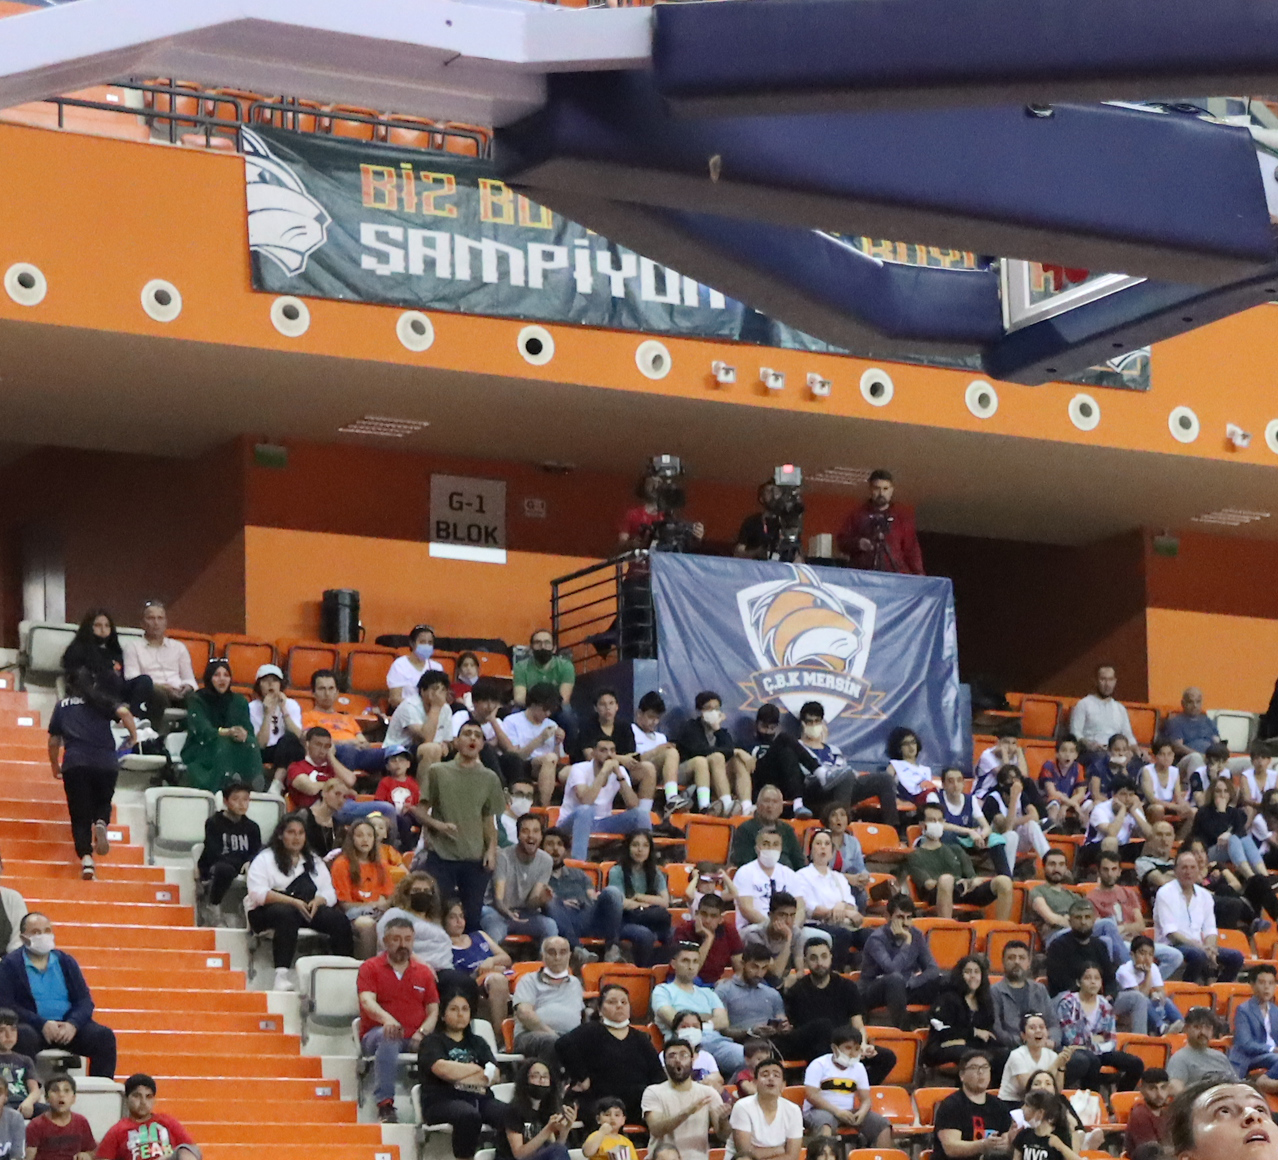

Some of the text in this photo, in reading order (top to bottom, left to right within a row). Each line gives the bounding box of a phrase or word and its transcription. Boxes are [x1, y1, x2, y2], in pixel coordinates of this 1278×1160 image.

[448, 491, 486, 514] G-1
[435, 520, 499, 544] BLOK
[803, 671, 862, 699] MERSİN
